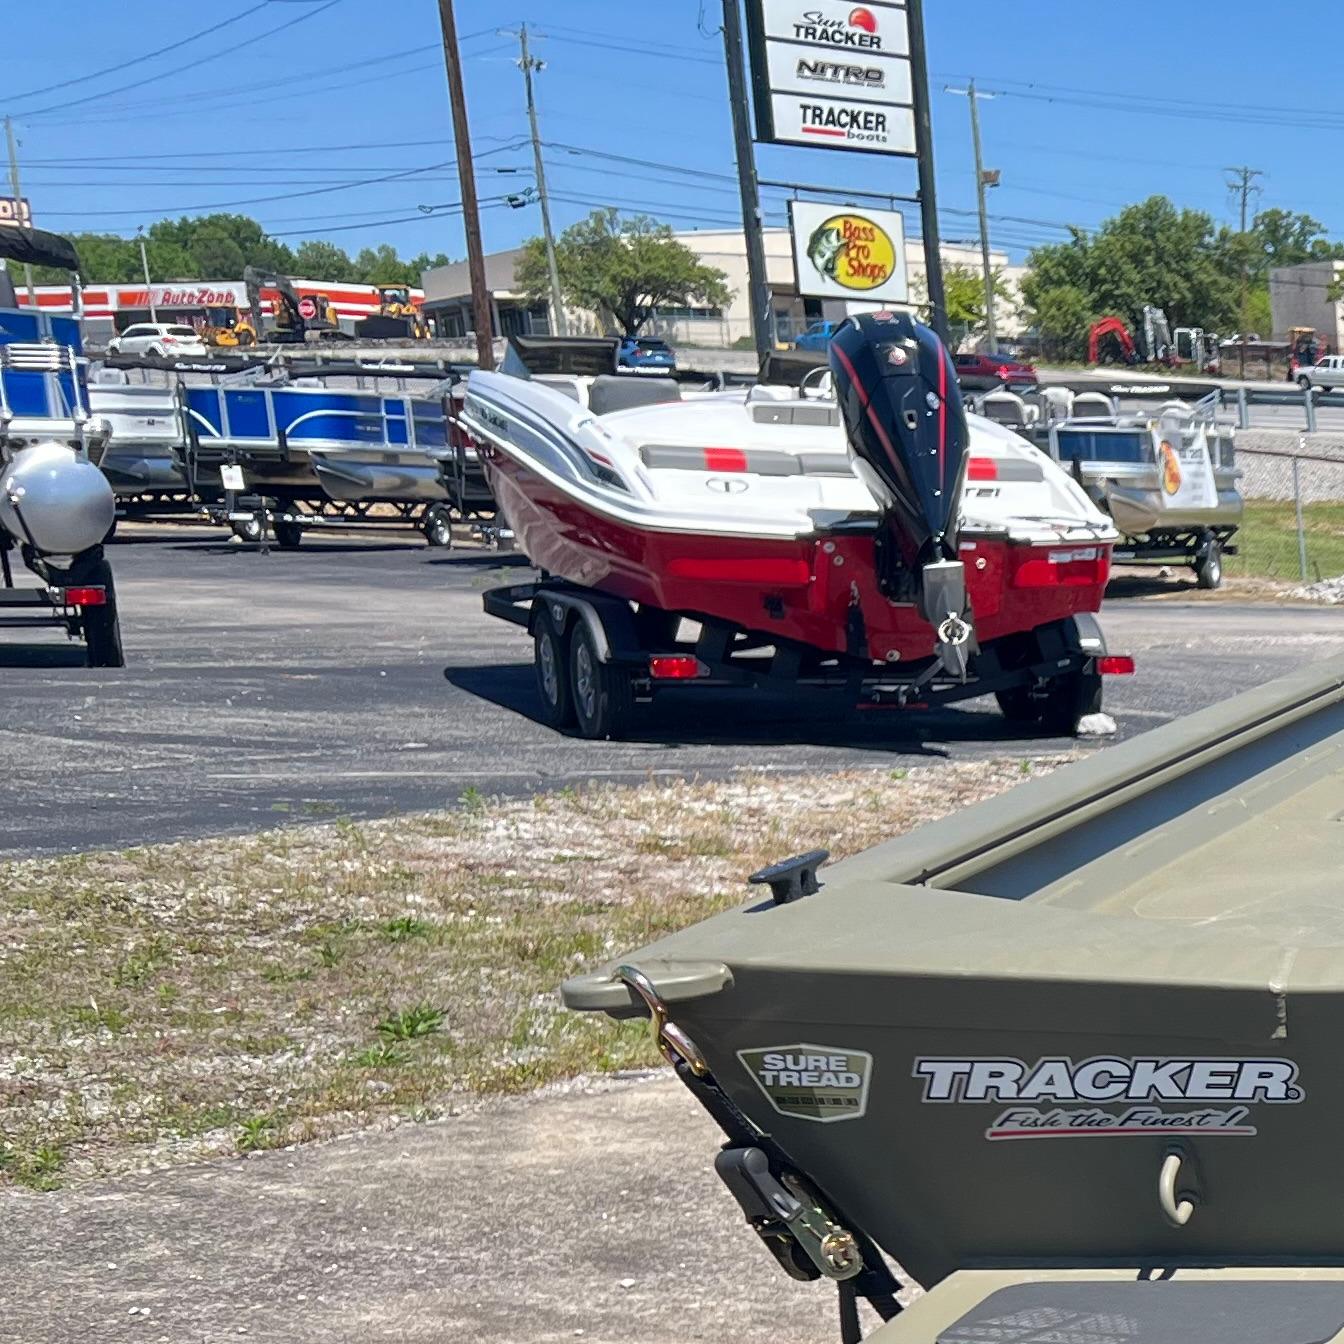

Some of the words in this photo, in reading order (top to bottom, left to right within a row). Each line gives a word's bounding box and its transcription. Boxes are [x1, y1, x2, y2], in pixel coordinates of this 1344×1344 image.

[802, 11, 845, 29] Sun
[793, 24, 882, 49] TRACKER
[796, 59, 885, 82] NITRO
[800, 104, 886, 132] TRACKER
[847, 129, 888, 142] boats
[843, 219, 875, 242] Bass
[845, 240, 870, 260] Pro
[847, 258, 887, 283] Shops
[763, 1054, 847, 1071] SURE
[759, 1070, 861, 1088] TREAD
[918, 1060, 1293, 1100] TRACKER
[997, 1110, 1062, 1127] Fish
[1068, 1111, 1113, 1127] the
